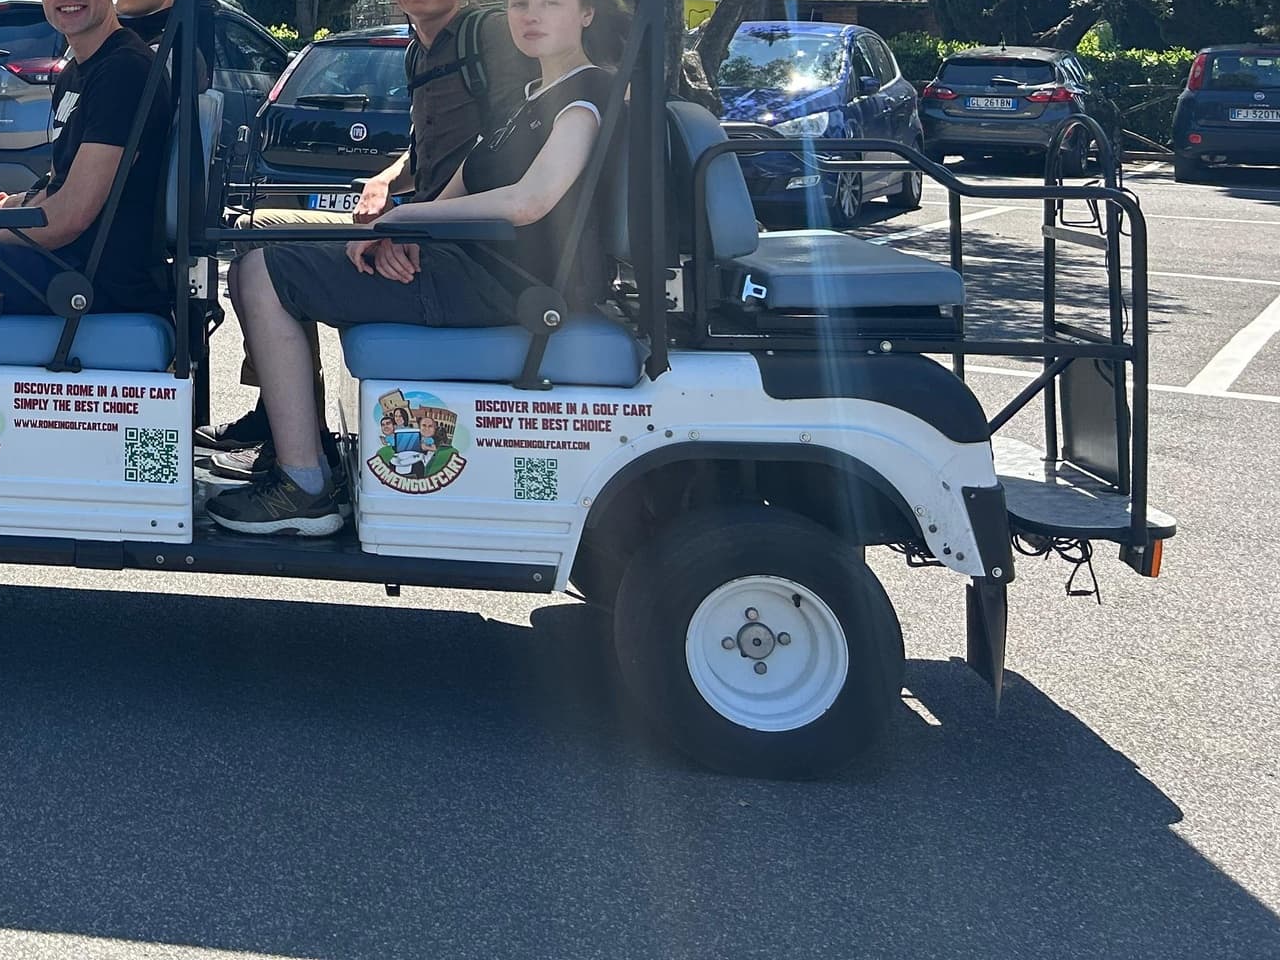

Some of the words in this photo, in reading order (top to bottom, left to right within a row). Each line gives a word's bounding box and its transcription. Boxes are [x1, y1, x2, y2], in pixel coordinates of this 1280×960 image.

[337, 146, 378, 154] PUNTO
[319, 193, 338, 209] EW
[14, 382, 63, 396] DISCOVER
[66, 384, 94, 397] ROME
[97, 385, 108, 398] IN
[111, 386, 118, 398] A
[121, 387, 146, 399] GOLF
[149, 388, 177, 400] CART
[14, 398, 48, 411] SIMPLY
[53, 399, 71, 412] THE
[74, 400, 99, 413] BEST
[103, 401, 139, 414] CHOICE
[475, 400, 529, 414] DISCOVER
[532, 402, 562, 414] ROME
[566, 402, 577, 415] IN
[580, 403, 589, 415] A
[593, 403, 620, 416] GOLF
[623, 404, 653, 417] CART
[14, 419, 119, 432] WWW.ROMEINGOLFCART.COM
[475, 416, 513, 430] SIMPLY
[519, 417, 538, 430] THE
[542, 418, 569, 431] BEST
[573, 419, 612, 432] CHOICE
[475, 438, 591, 451] WWW.ROMEINGOLFCART.COM
[369, 455, 466, 493] ROMEINGOLFCART
